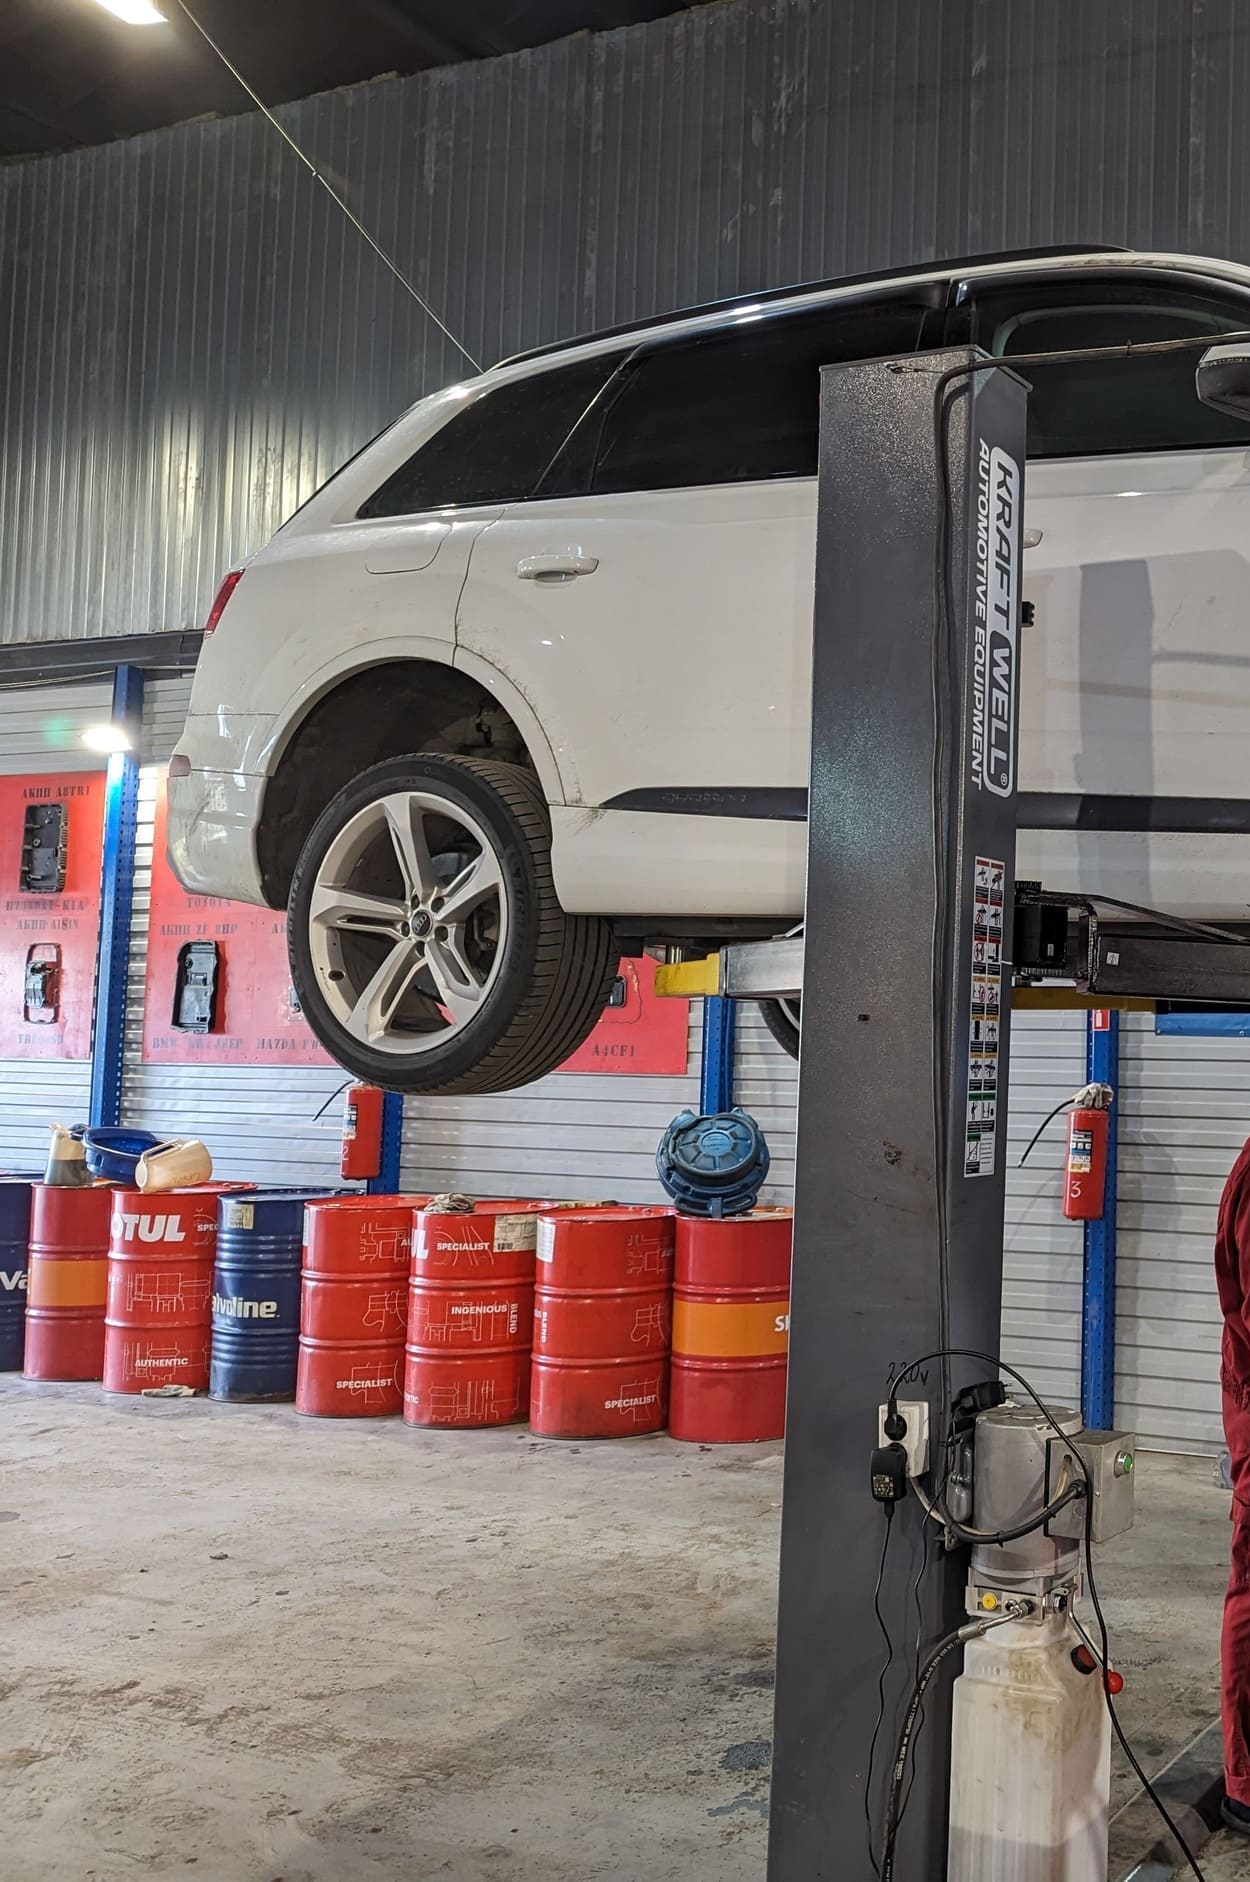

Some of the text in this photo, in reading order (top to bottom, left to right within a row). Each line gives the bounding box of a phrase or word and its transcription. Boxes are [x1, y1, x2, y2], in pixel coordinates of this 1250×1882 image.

[970, 438, 990, 790] AUTOMOTIVE EQUIPMENT
[1070, 1181, 1082, 1198] 3
[111, 1213, 186, 1242] OTUL
[436, 1241, 491, 1251] SPECIALIST
[211, 1292, 278, 1319] alvoline
[451, 1304, 508, 1315] INGENIOUS
[510, 1303, 519, 1334] BLEND
[135, 1357, 189, 1368] AUTHENTIC
[336, 1378, 393, 1390] SPECIALIST
[604, 1394, 657, 1409] SPECIALIST
